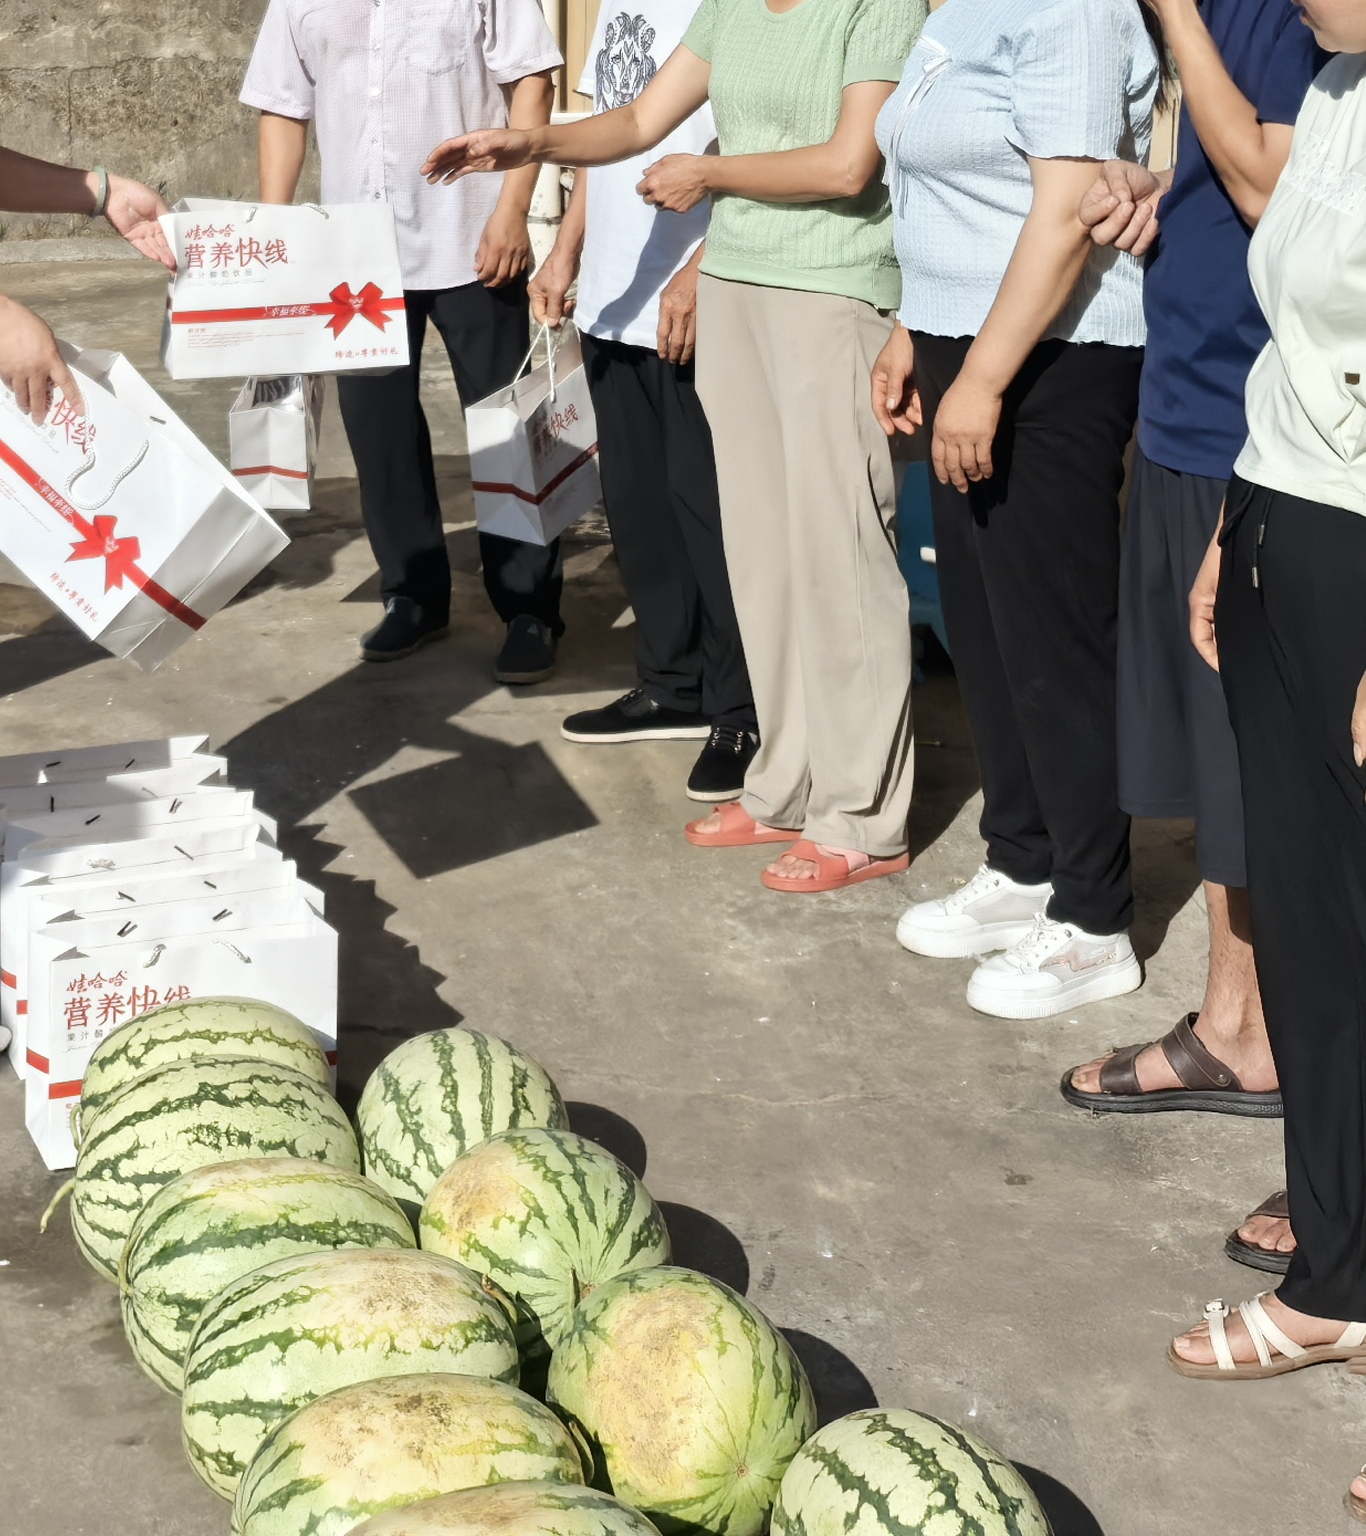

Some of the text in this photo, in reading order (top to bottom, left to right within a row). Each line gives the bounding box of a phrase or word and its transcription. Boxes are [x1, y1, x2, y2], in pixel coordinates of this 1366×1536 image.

[185, 224, 235, 240] 娃哈哈
[184, 237, 288, 269] 营养快线
[66, 970, 128, 993] 娃哈哈
